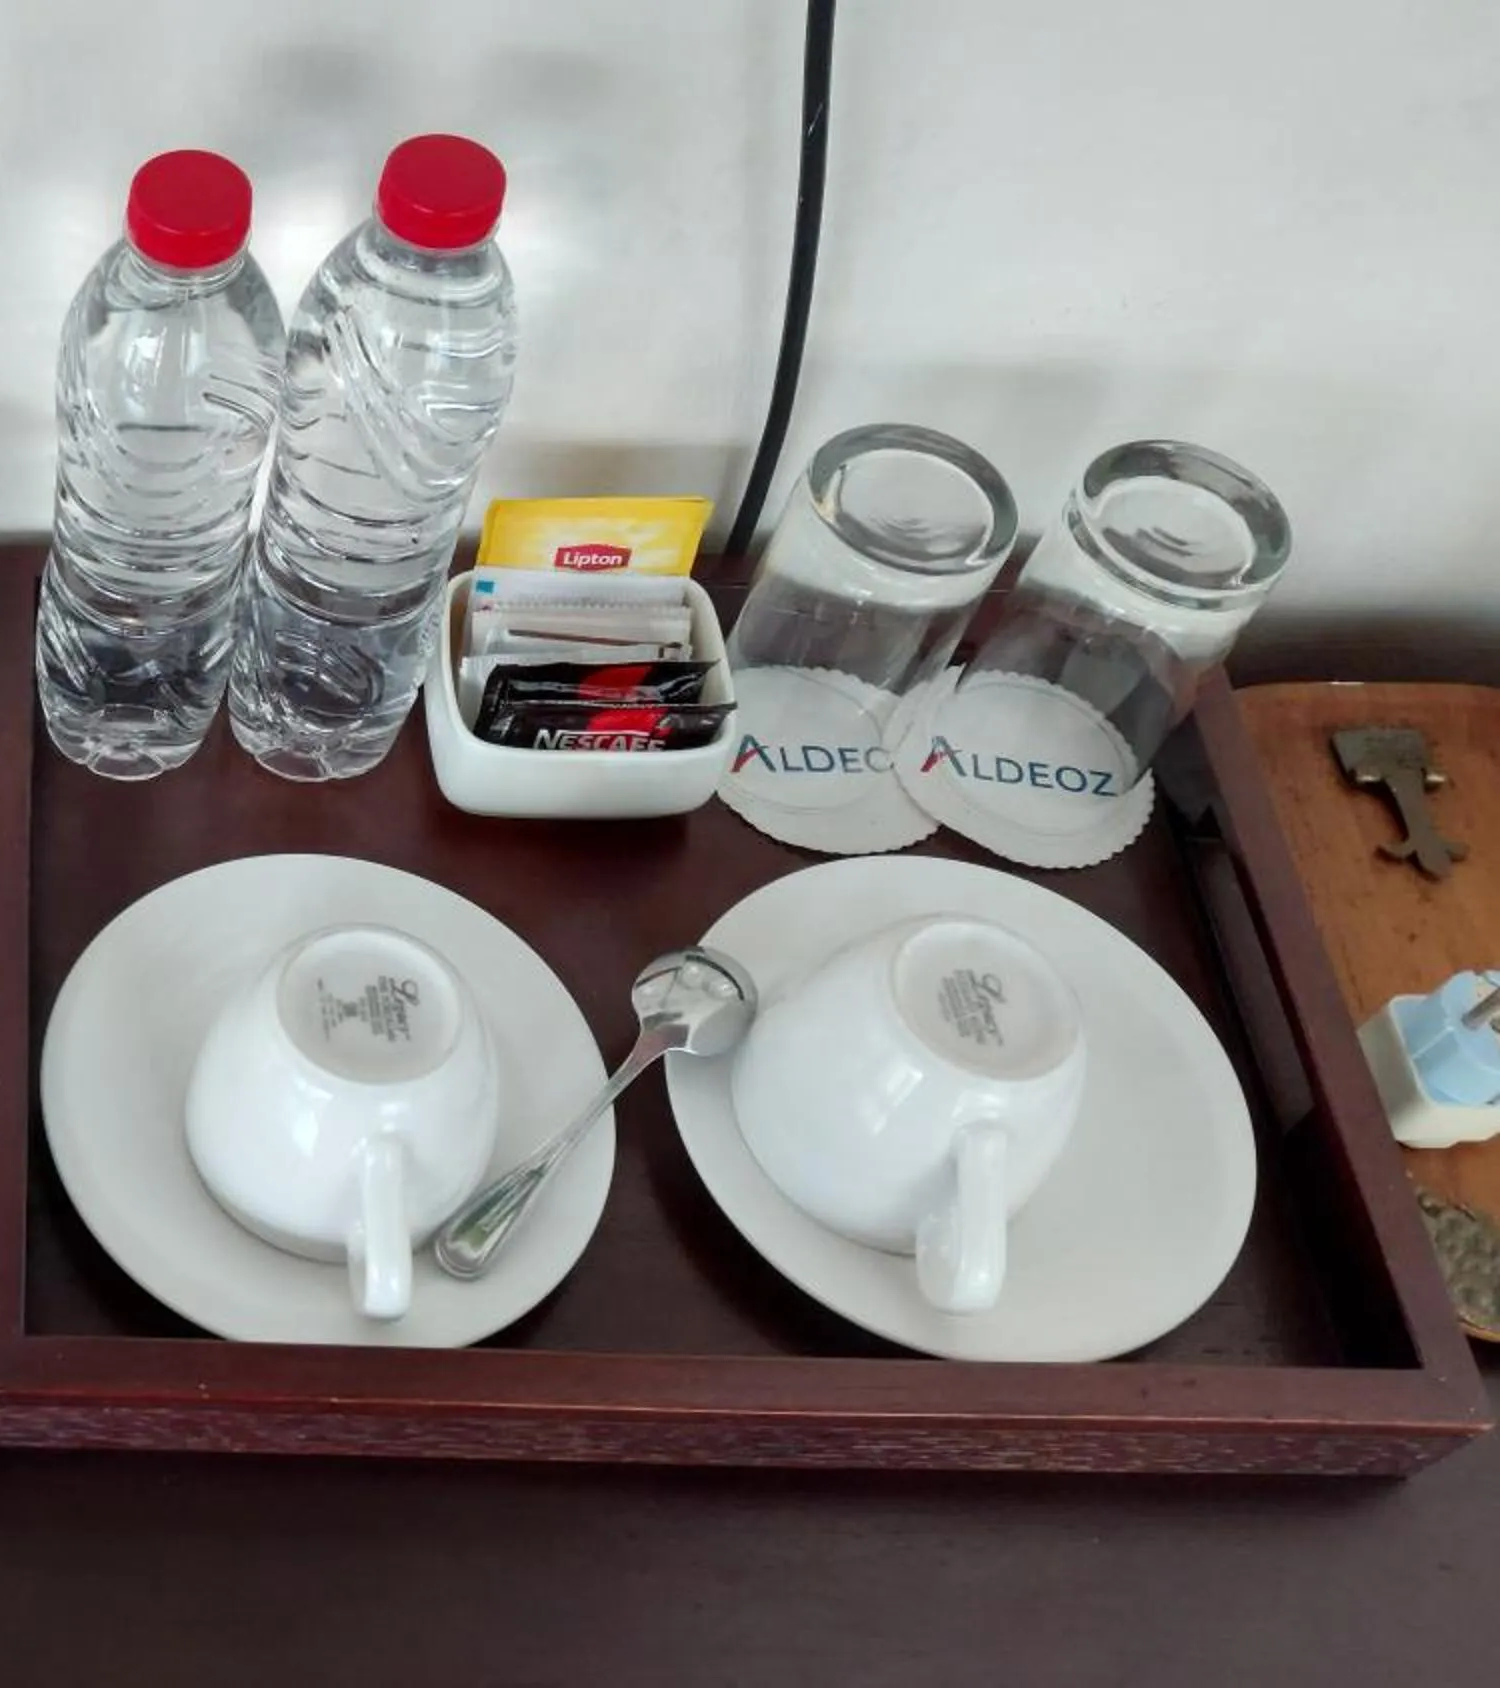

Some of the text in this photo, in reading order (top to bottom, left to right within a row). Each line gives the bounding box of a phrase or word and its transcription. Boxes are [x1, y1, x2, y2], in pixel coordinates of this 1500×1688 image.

[563, 551, 623, 568] Lipton
[729, 734, 894, 774] ALDEO
[920, 735, 1119, 798] ALDEOZ
